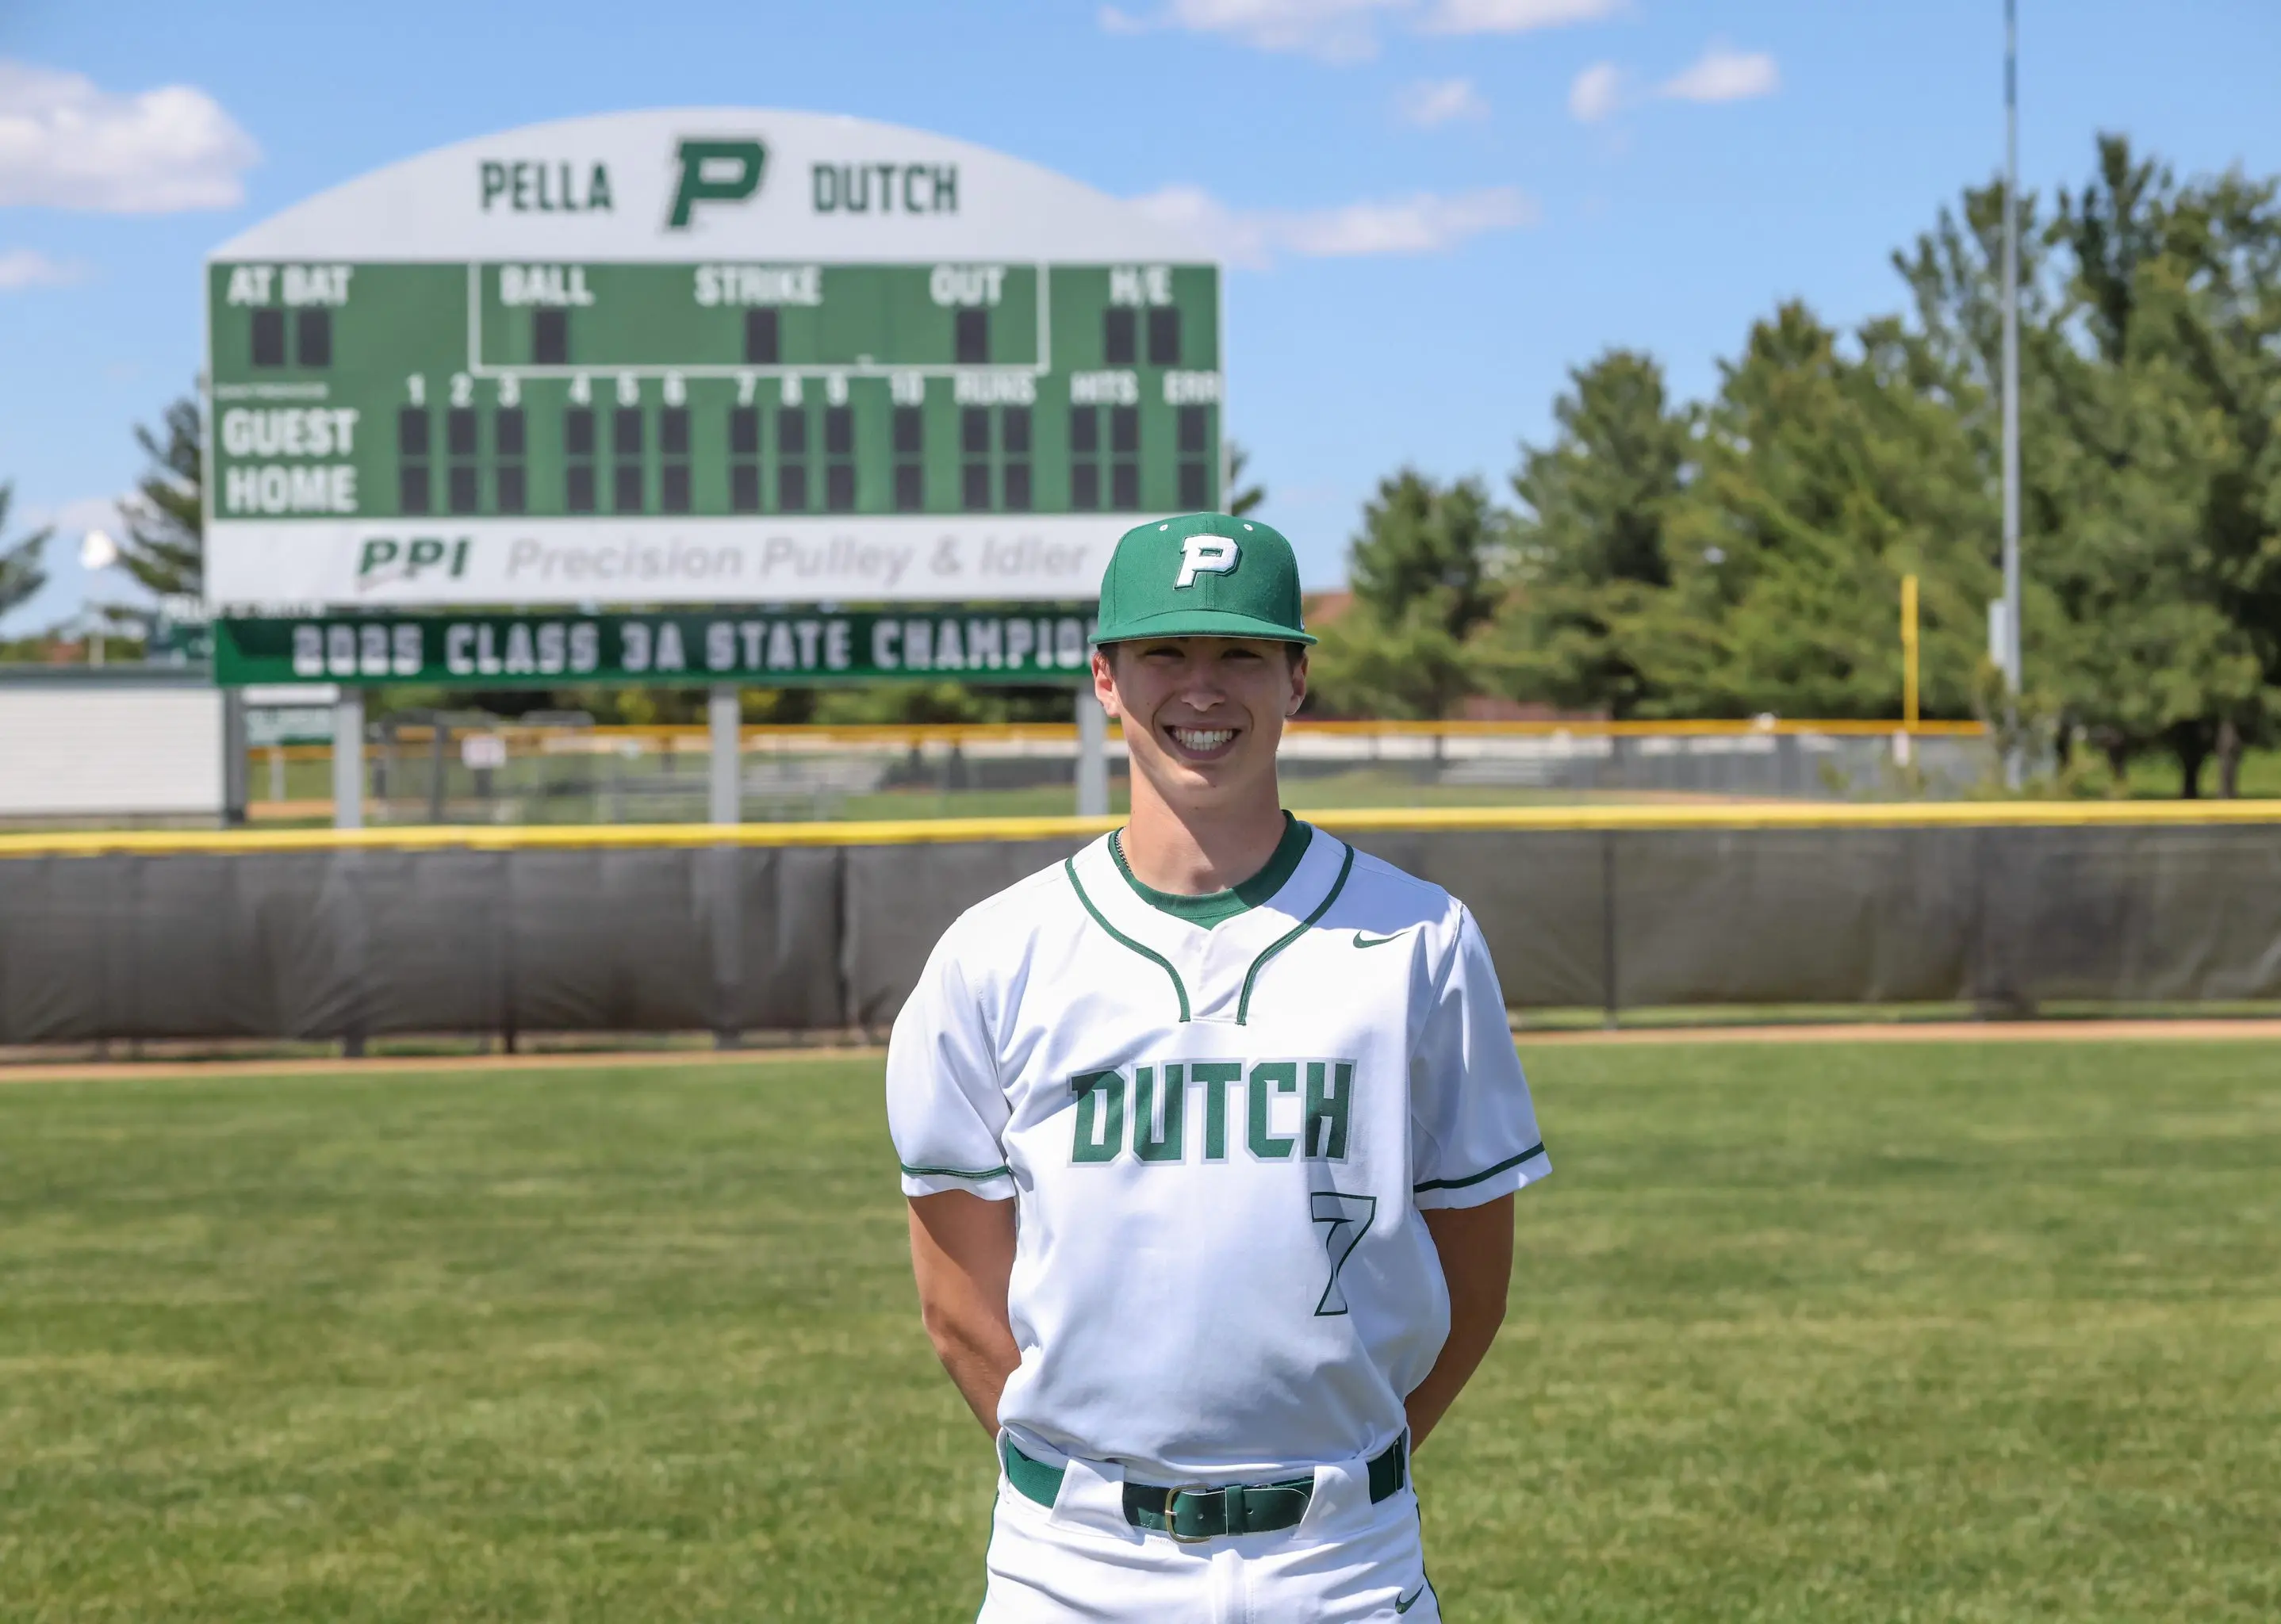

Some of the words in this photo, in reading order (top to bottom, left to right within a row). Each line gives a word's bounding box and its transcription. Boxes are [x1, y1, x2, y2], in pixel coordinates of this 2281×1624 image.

[481, 161, 613, 212] PELLA
[667, 137, 768, 230] P
[812, 163, 959, 215] DUTCH
[227, 266, 276, 307] AT
[282, 266, 354, 307] BAT
[500, 266, 595, 307] BALL
[694, 266, 823, 307] STRIKE
[930, 266, 1007, 307] OUT
[407, 373, 425, 407] 1
[450, 373, 474, 407] 2
[498, 373, 521, 407] 3
[569, 373, 592, 407] 4
[616, 373, 639, 407] 5
[663, 373, 688, 407] 6
[737, 373, 757, 407] 7
[781, 373, 803, 407] 8
[826, 373, 849, 407] 9
[889, 373, 926, 407] 10
[953, 370, 1037, 406] RUNS
[1071, 370, 1138, 405] HITS
[221, 407, 359, 457] GUEST
[225, 464, 358, 514] HOME
[358, 536, 473, 580] PPI
[506, 538, 742, 581] Precision
[759, 534, 916, 587] Pulley
[928, 536, 962, 577] &
[978, 534, 1090, 577] Idler
[1173, 533, 1243, 590] P
[291, 623, 424, 677] 2025
[444, 622, 600, 676] CLASS
[619, 620, 687, 674] 3A
[704, 619, 853, 672] STATE
[1068, 1058, 1356, 1167] DUTCH
[1310, 1192, 1377, 1317] 7
